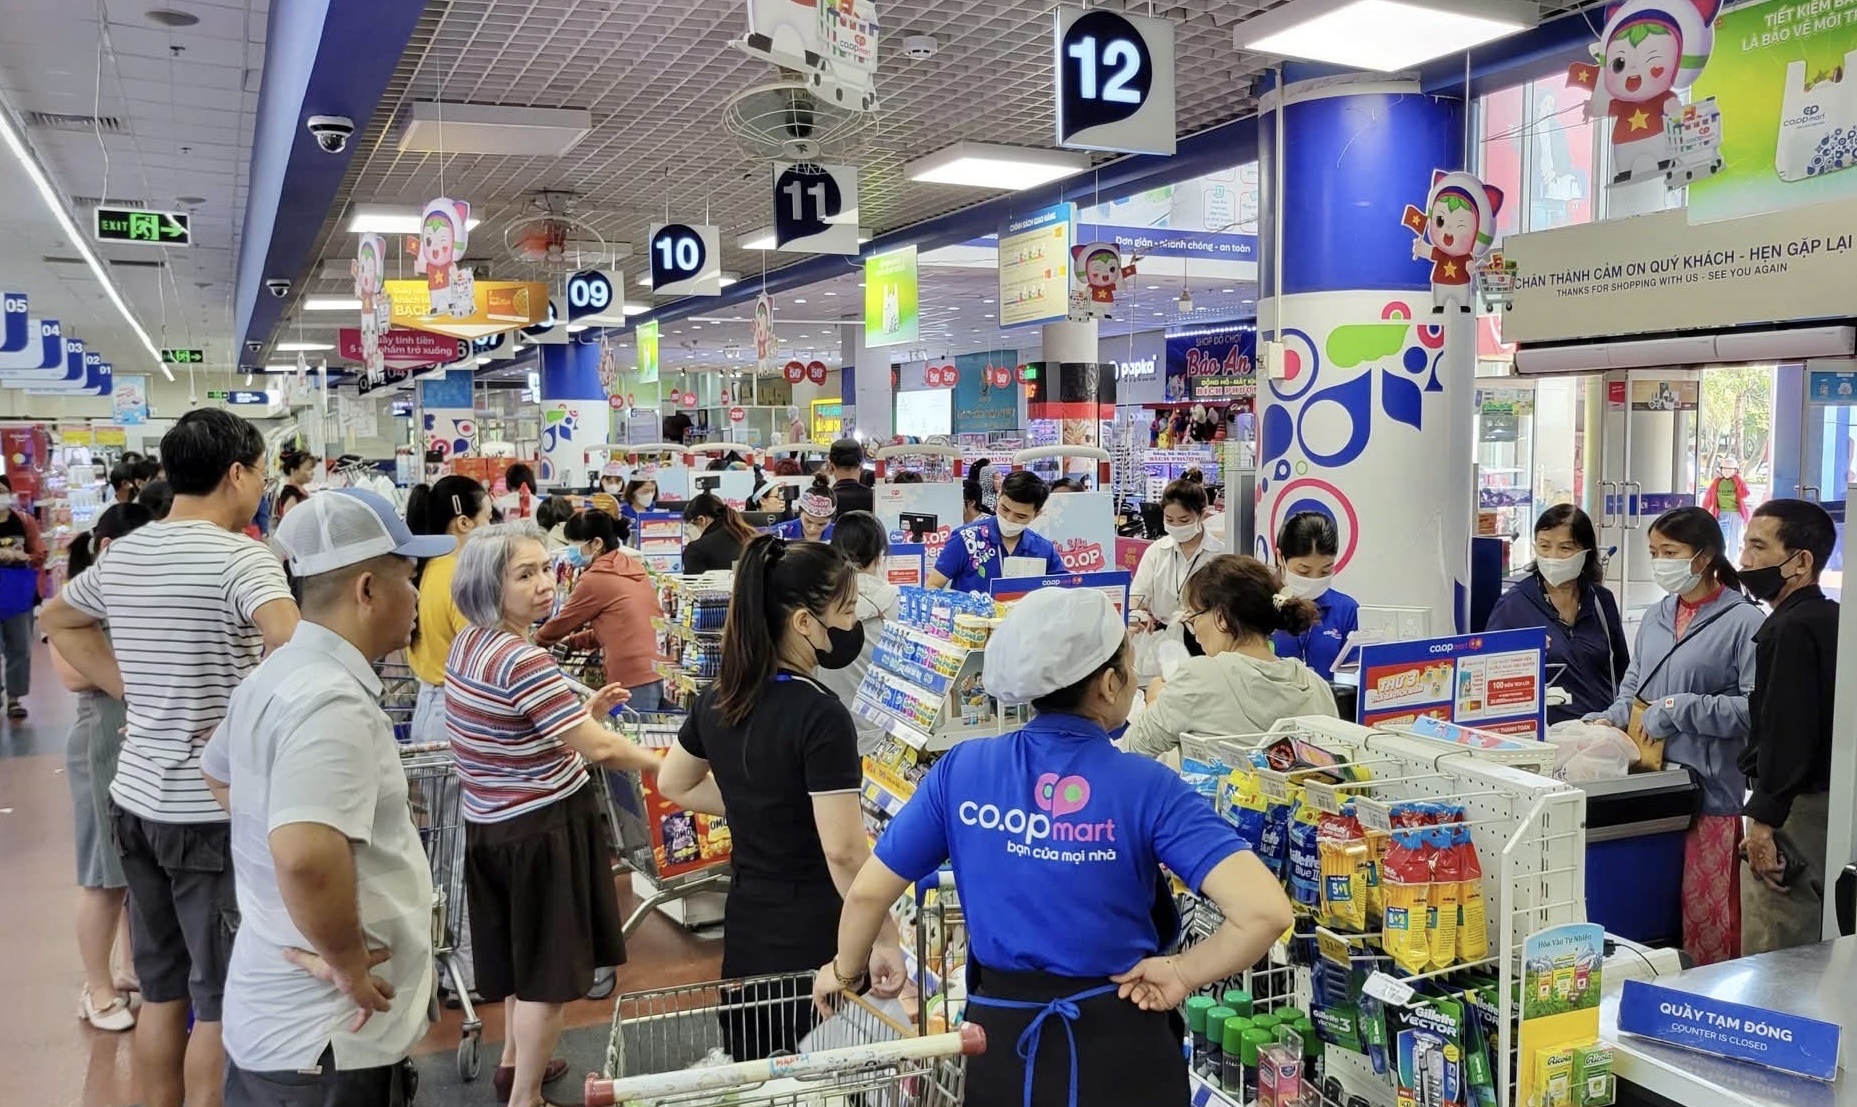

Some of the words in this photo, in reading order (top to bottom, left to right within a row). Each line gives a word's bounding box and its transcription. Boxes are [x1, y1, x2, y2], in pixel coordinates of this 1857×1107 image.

[1742, 37, 1758, 52] LÀ
[1069, 36, 1141, 104] 12
[782, 180, 828, 222] 11
[102, 219, 129, 231] EXIT
[1116, 235, 1133, 246] Đơn
[1134, 236, 1153, 248] giản
[1188, 240, 1213, 252] chóng
[1220, 244, 1231, 252] an
[1232, 243, 1251, 253] toàn
[656, 237, 700, 271] 10
[1549, 264, 1591, 286] THÀNH
[1593, 261, 1623, 280] CẢM
[1626, 261, 1646, 277] ƠN
[1650, 252, 1679, 273] QUÝ
[1683, 249, 1735, 269] KHÁCH
[1749, 242, 1782, 264] HẸN
[1786, 235, 1821, 257] GẶP
[1826, 234, 1853, 255] LẠI
[1556, 283, 1589, 298] THANKS
[1591, 282, 1609, 294] FOR
[1611, 277, 1657, 292] SHOPPING
[1659, 274, 1683, 287] WITH
[1685, 272, 1699, 284] US
[1708, 269, 1727, 281] SEE
[1730, 265, 1751, 278] YOU
[1754, 262, 1788, 275] AGAIN
[570, 280, 609, 308] 09
[5, 299, 28, 313] 05
[42, 324, 60, 336] 04
[67, 342, 83, 353] 03
[86, 355, 100, 365] 02
[1121, 357, 1155, 379] papka
[1222, 344, 1252, 377] An
[99, 365, 111, 374] 01
[1063, 549, 1100, 568] O.OP
[1407, 672, 1418, 687] 3
[1493, 681, 1504, 689] 100
[674, 829, 692, 840] OMO
[1007, 840, 1031, 857] bạn
[1033, 845, 1059, 860] của
[1061, 850, 1085, 865] mọi
[1088, 848, 1117, 861] nhà
[1295, 864, 1312, 877] Blue
[1332, 881, 1349, 896] 5+1
[1313, 1009, 1338, 1023] Gillette
[1415, 1006, 1457, 1027] Gillette
[1660, 1002, 1706, 1022] QUẦY
[1708, 1011, 1740, 1031] TẠM
[1744, 1020, 1794, 1043] ĐÓNG
[1399, 1012, 1458, 1038] VECTOR
[1671, 1022, 1717, 1040] COUNTER
[1718, 1033, 1728, 1042] IS
[1728, 1035, 1768, 1052] CLOSED
[1547, 1054, 1572, 1066] Ricola
[1584, 1051, 1613, 1066] Ricola
